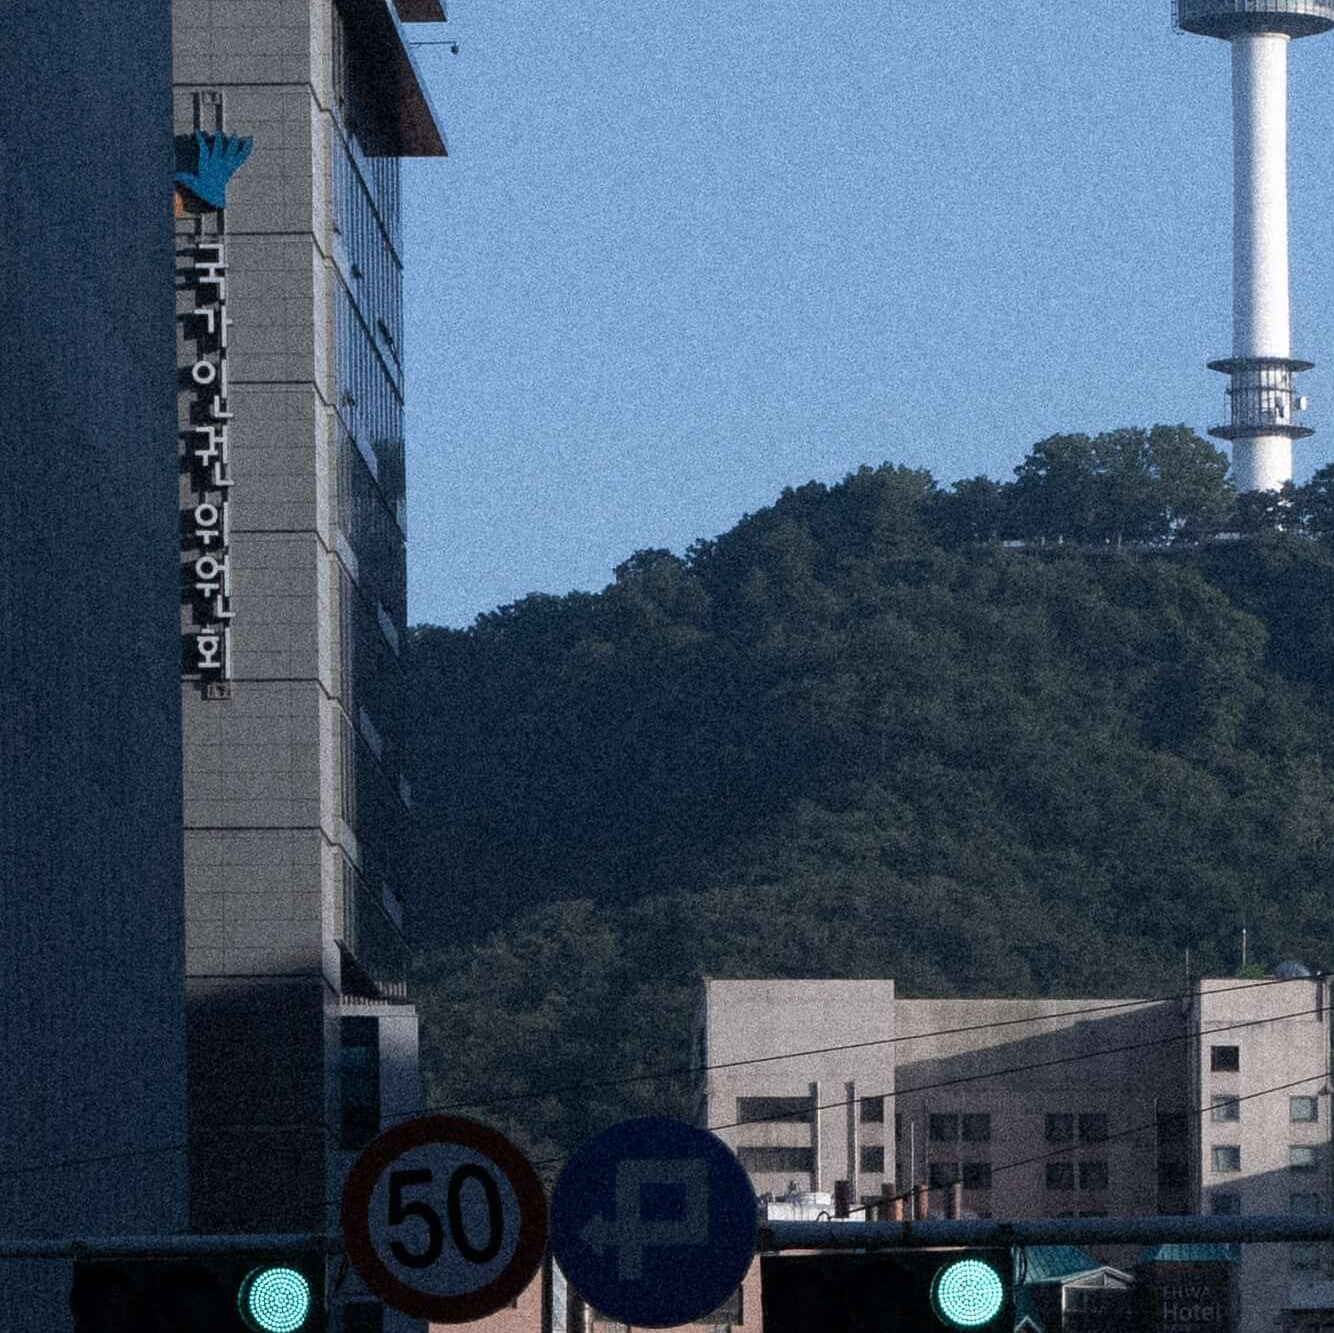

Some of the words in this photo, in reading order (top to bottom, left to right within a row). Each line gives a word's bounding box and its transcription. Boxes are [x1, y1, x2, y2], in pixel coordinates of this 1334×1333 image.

[193, 243, 235, 681] 국가인권위원회
[388, 1163, 502, 1269] 50
[1162, 1302, 1221, 1322] Hotel
